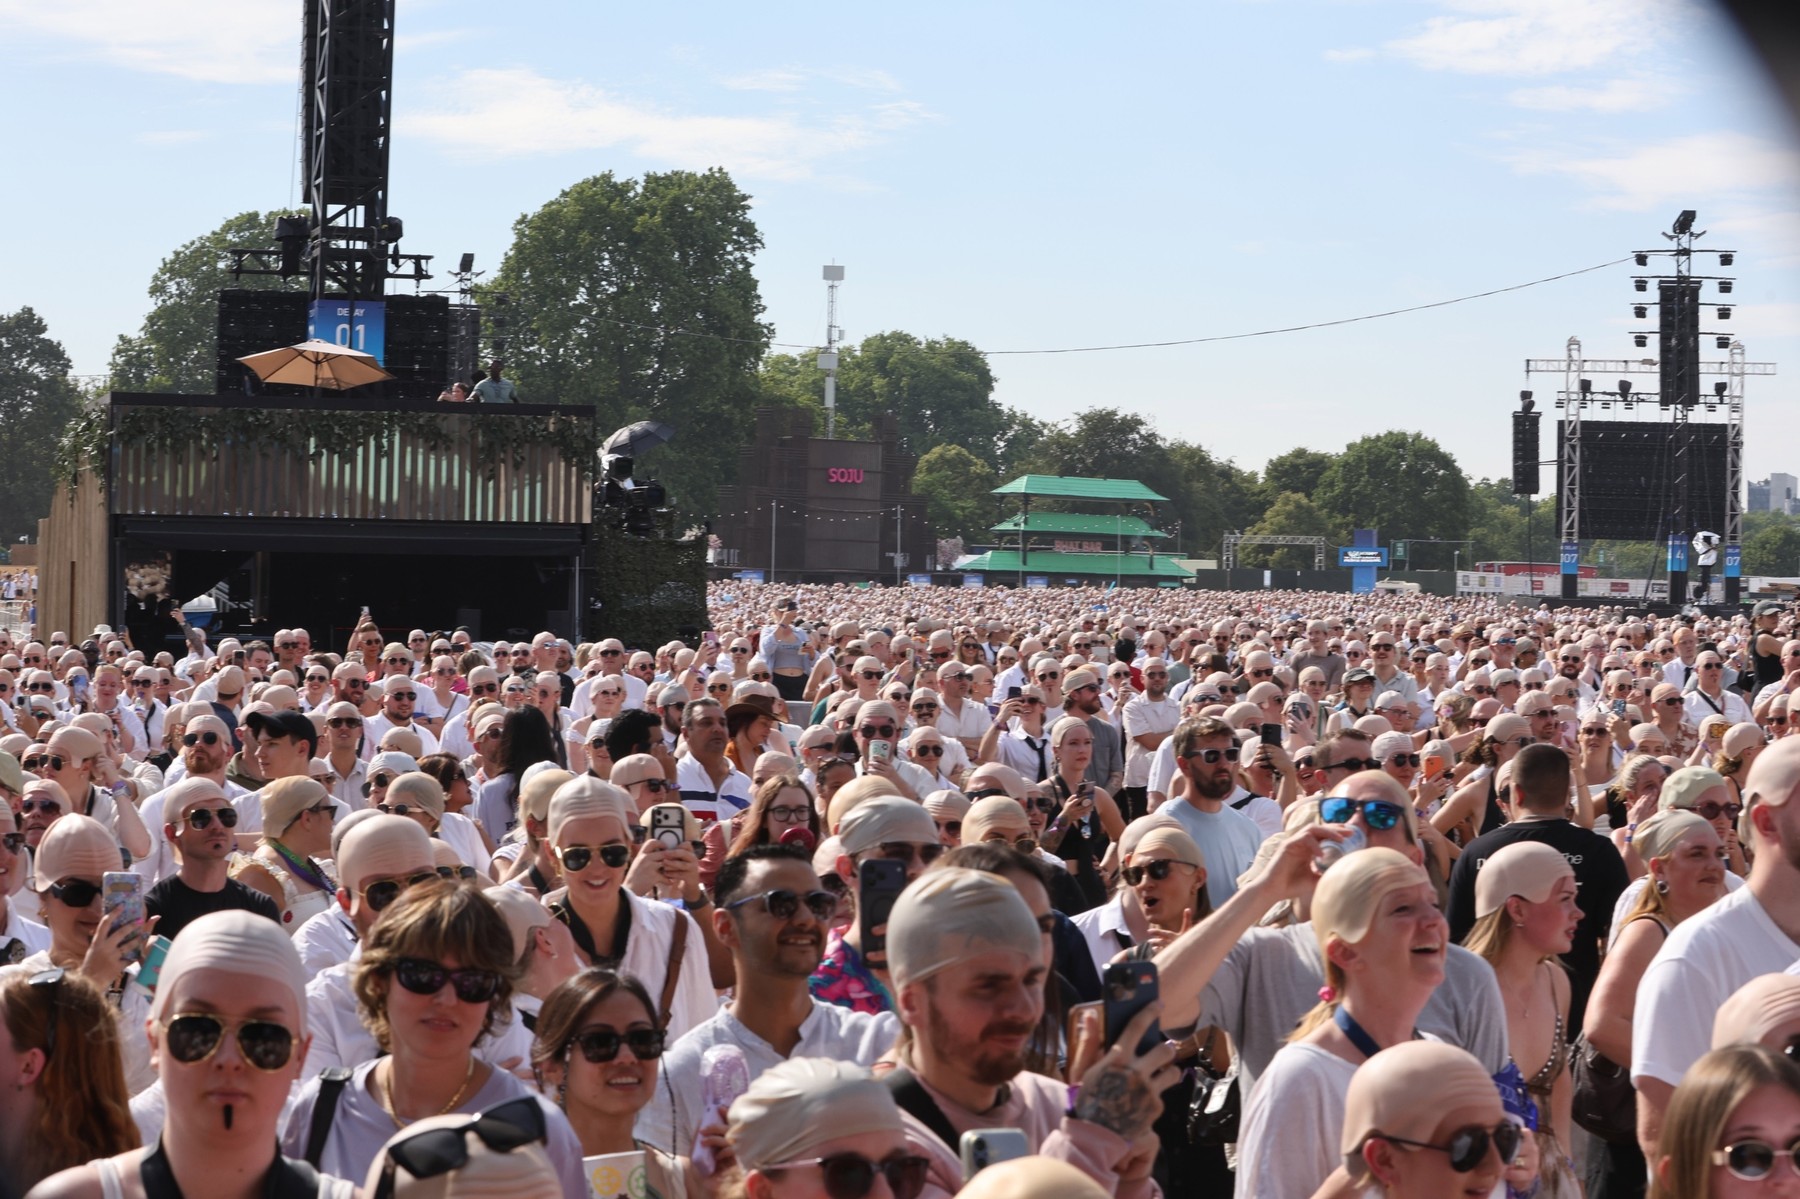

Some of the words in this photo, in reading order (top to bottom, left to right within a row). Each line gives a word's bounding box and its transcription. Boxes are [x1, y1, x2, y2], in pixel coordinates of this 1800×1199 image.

[336, 308, 365, 317] DEAY
[335, 323, 366, 350] 01
[828, 467, 864, 484] SOJU
[1726, 556, 1741, 566] 07
